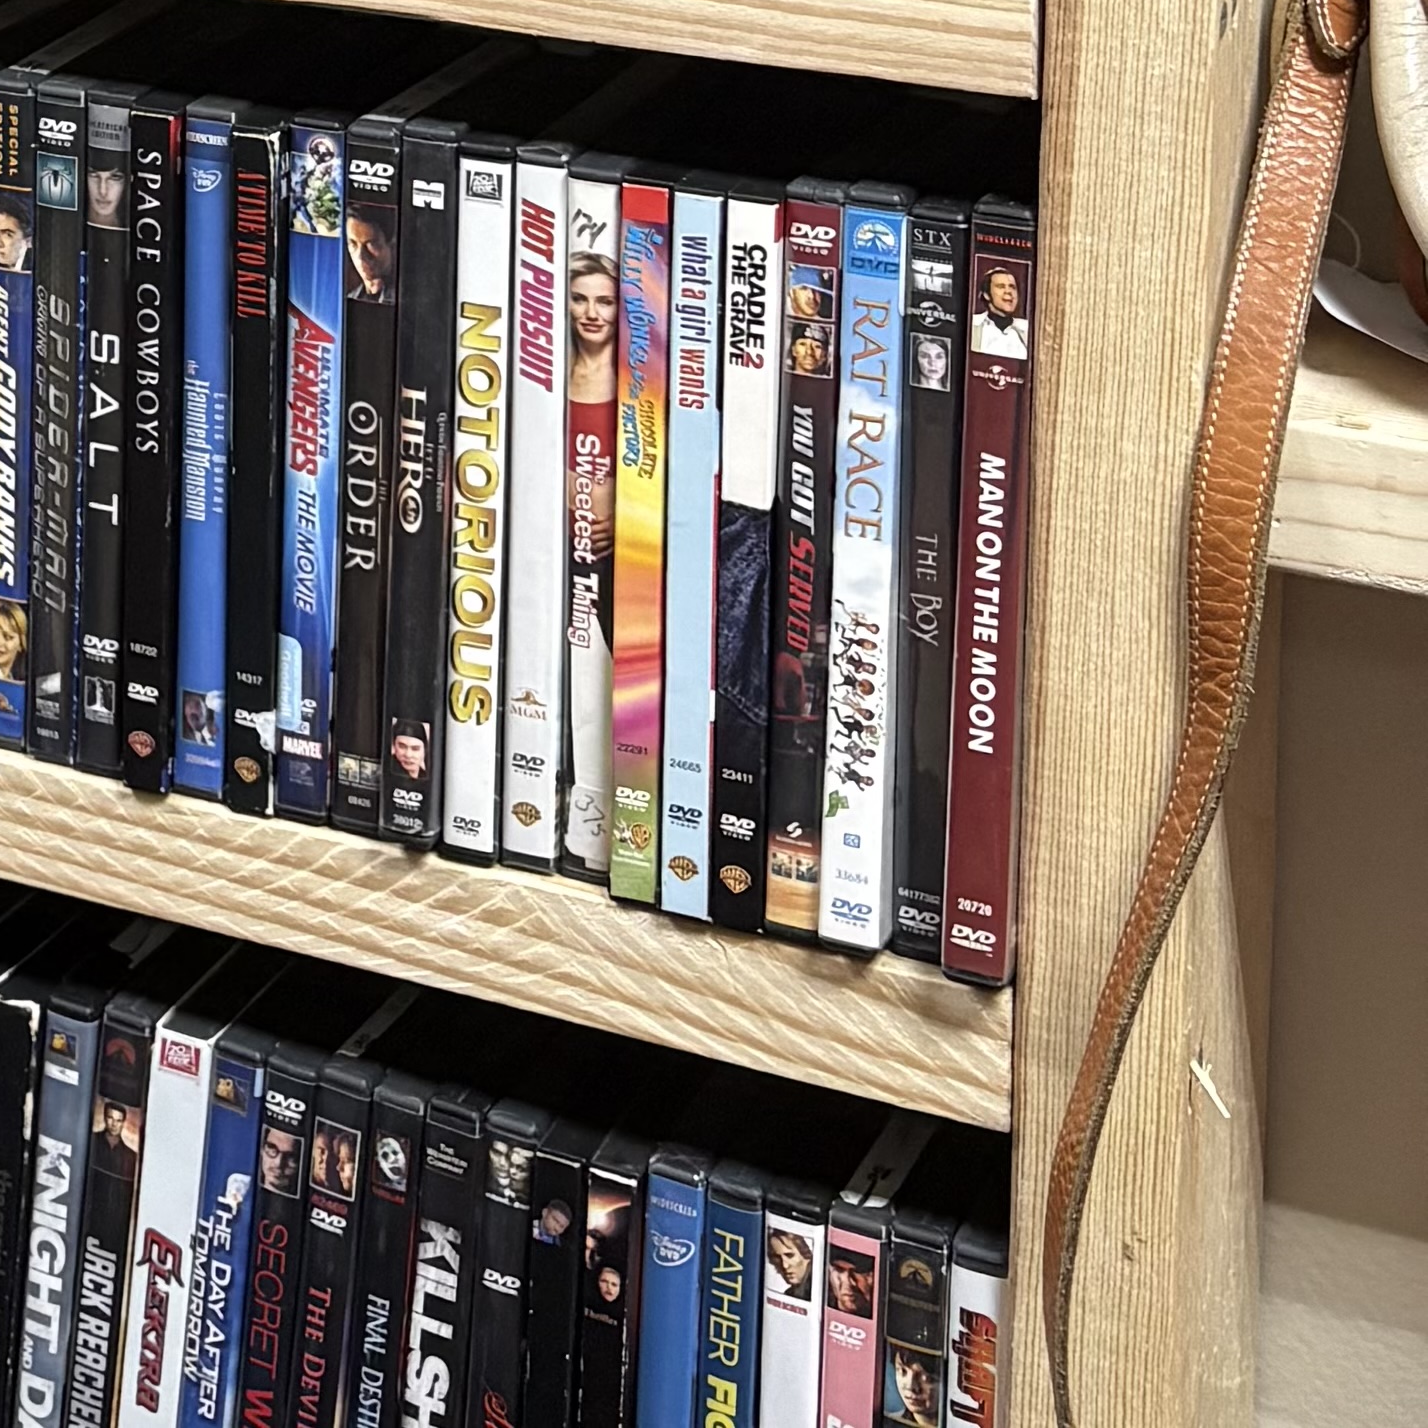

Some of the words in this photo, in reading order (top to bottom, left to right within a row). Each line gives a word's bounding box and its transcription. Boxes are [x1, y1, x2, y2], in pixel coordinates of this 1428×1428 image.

[136, 148, 162, 263] SPACE
[136, 283, 161, 454] COWBOYS
[848, 299, 890, 400] RAT
[88, 330, 120, 526] SALT
[346, 401, 380, 570] ORDER
[844, 412, 886, 542] RACE
[977, 452, 1006, 528] MAN
[449, 301, 506, 729] NOTORIOUS
[975, 531, 1003, 581] ON
[973, 586, 1000, 643] THE
[968, 648, 997, 754] MOON
[25, 1135, 73, 1355] KNIGHT
[709, 1228, 745, 1367] FATHER
